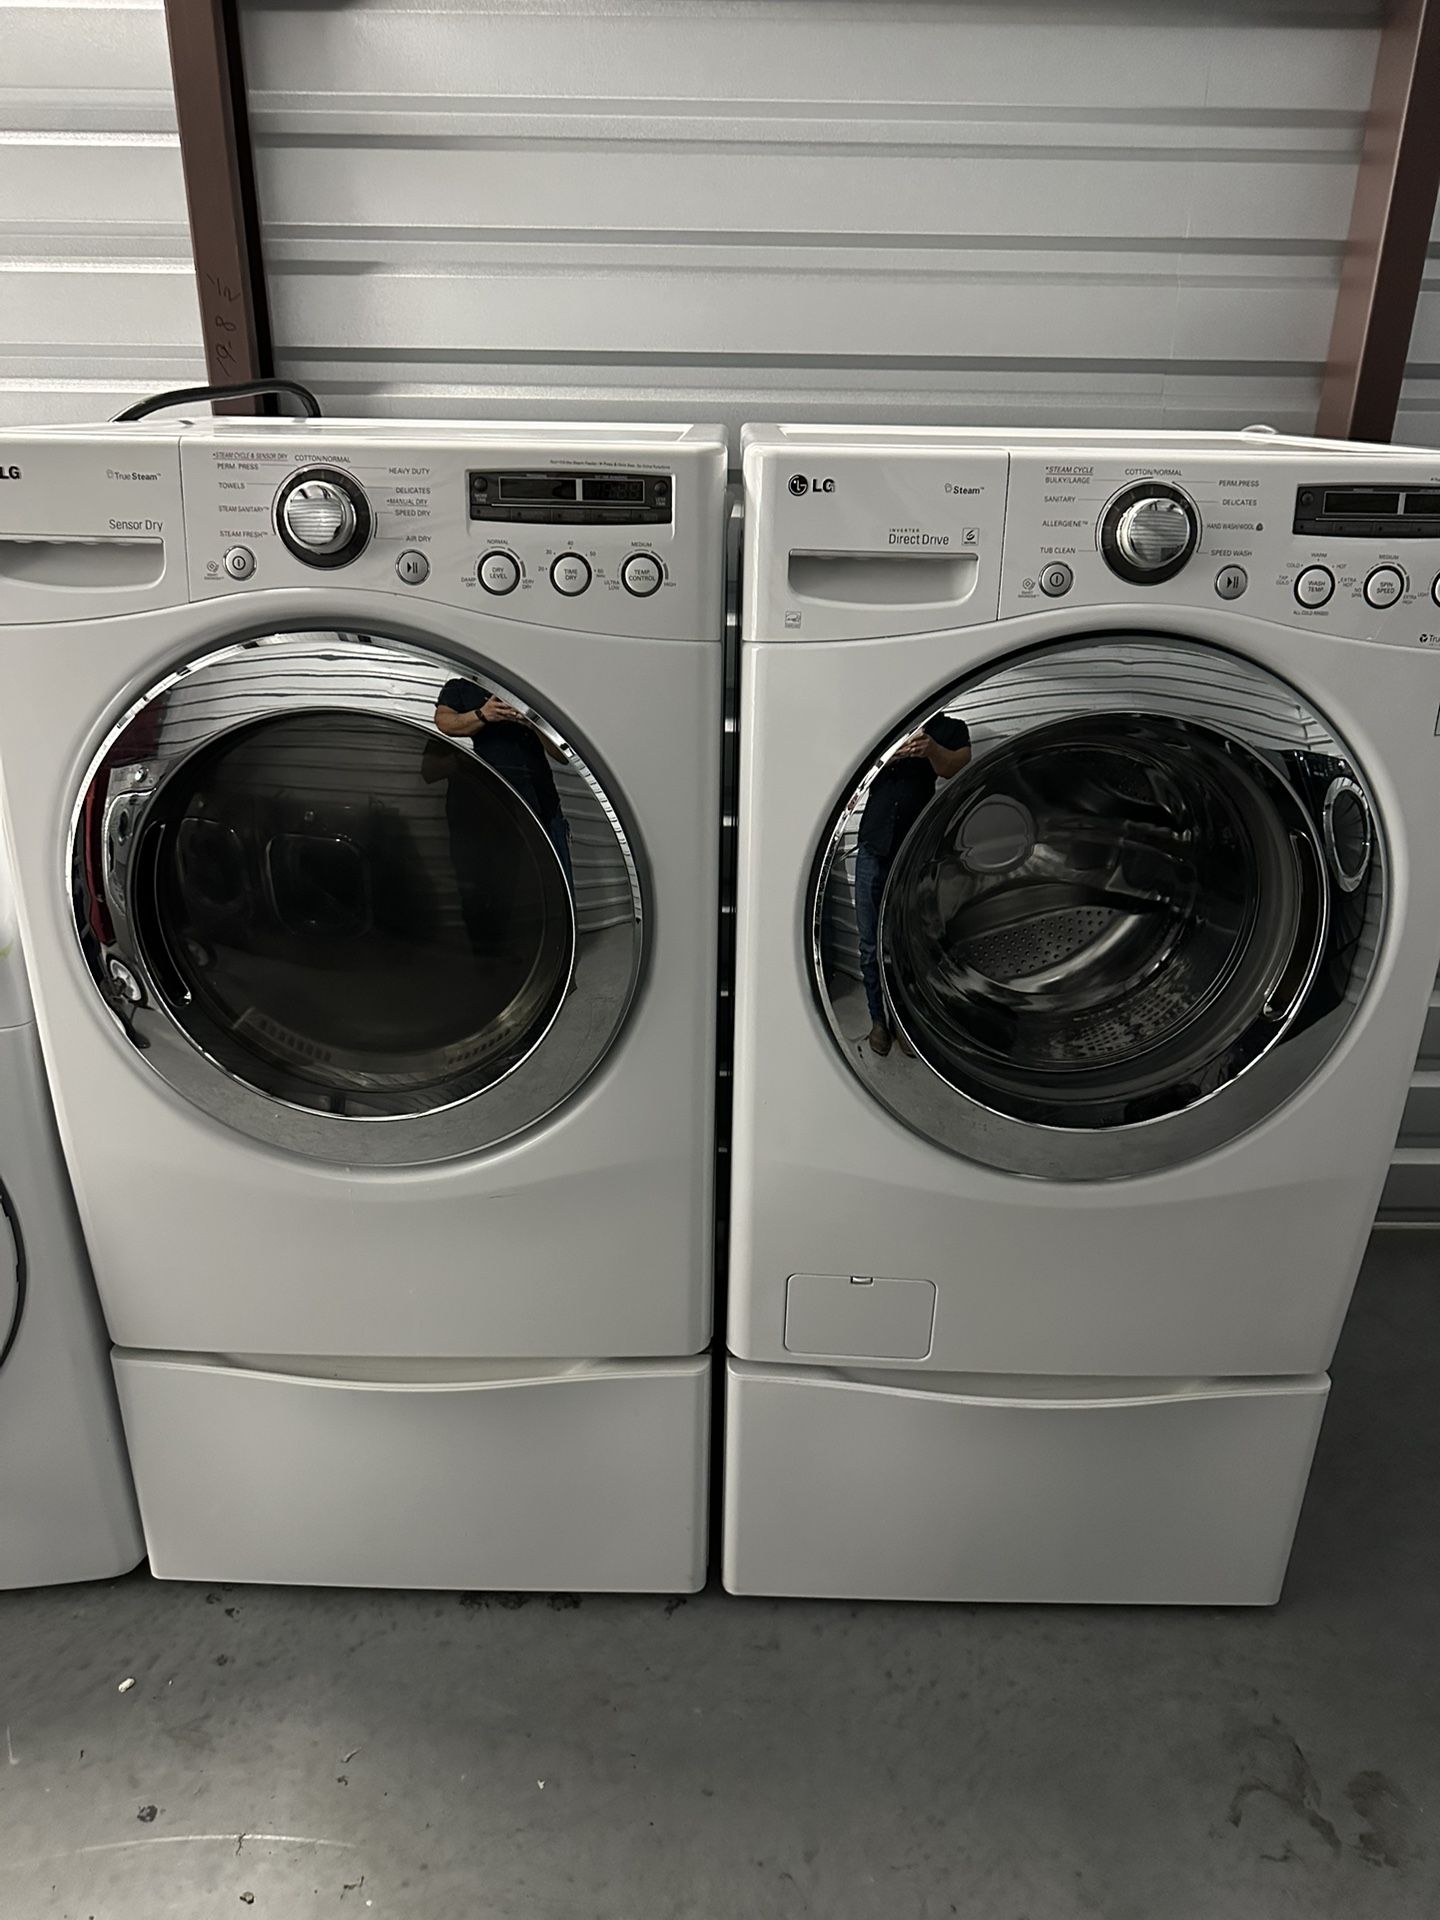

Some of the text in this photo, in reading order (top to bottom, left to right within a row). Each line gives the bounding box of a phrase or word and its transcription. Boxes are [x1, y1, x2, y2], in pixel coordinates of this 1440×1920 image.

[295, 454, 350, 464] COTTON/NORMAL
[388, 467, 431, 476] HEAVY DUTY
[1073, 466, 1095, 474] CYCLE
[1124, 468, 1183, 477] COTTON/NORMAL
[1045, 477, 1091, 485] BULKY/LARGE
[218, 482, 246, 490] TOWELS
[812, 478, 836, 493] LG
[395, 487, 431, 495] DELICATES
[1222, 499, 1257, 507] DELICATES
[395, 509, 416, 517] SPEED
[109, 519, 163, 532] Sensor Dry
[219, 530, 242, 538] STEAM
[888, 533, 950, 546] Direct Drive
[1054, 547, 1076, 555] CLEAN
[1210, 549, 1253, 557] SPEED WASH
[1376, 587, 1396, 595] SPEED
